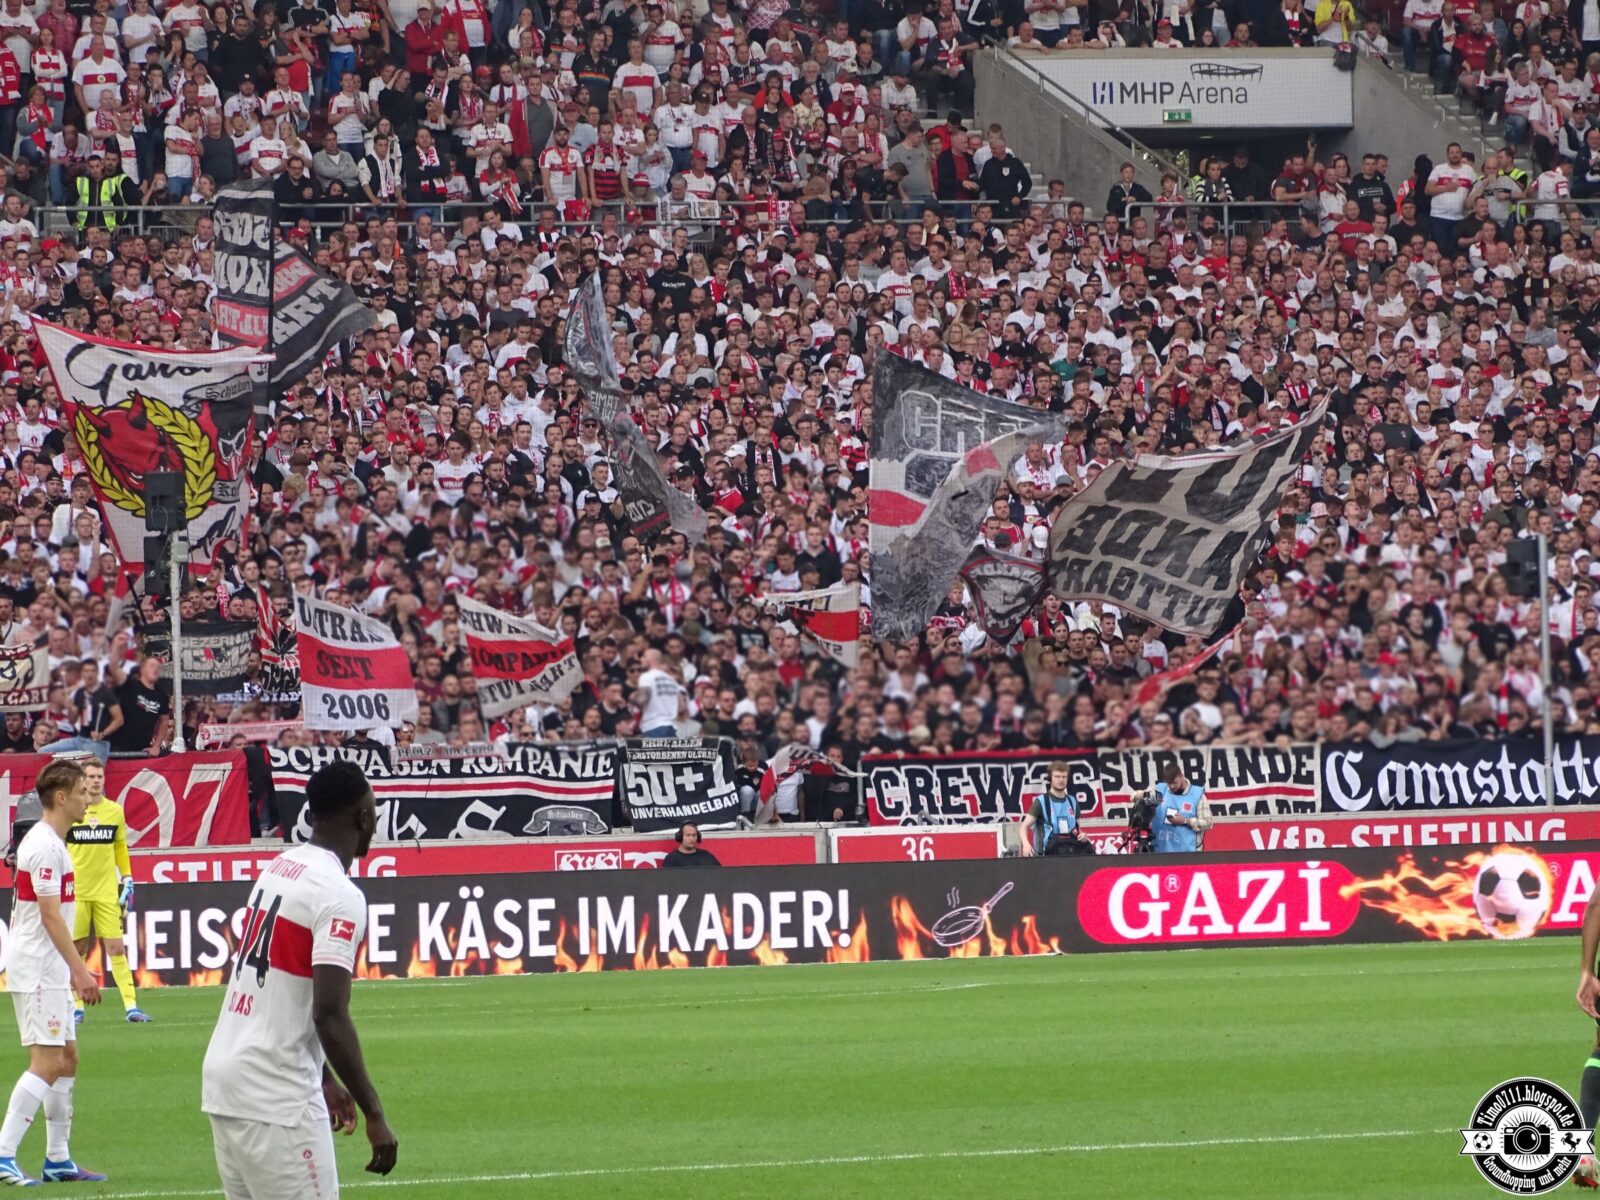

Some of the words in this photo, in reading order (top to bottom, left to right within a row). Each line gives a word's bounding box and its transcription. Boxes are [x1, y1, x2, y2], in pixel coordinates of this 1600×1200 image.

[1120, 82, 1175, 105] MHP
[1178, 81, 1248, 104] Arena
[316, 650, 375, 680] SEIT
[321, 692, 391, 721] 2006
[461, 746, 617, 779] KOMPANIE
[623, 755, 736, 806] 50+1
[871, 764, 1027, 820] CREW
[631, 792, 740, 819] UNVERHANDELBAR
[73, 829, 113, 841] WINAMAX
[902, 837, 934, 861] 36
[418, 885, 557, 961] KÄSE
[578, 896, 636, 955] IM
[657, 889, 852, 952] KADER!
[236, 888, 283, 989] 14
